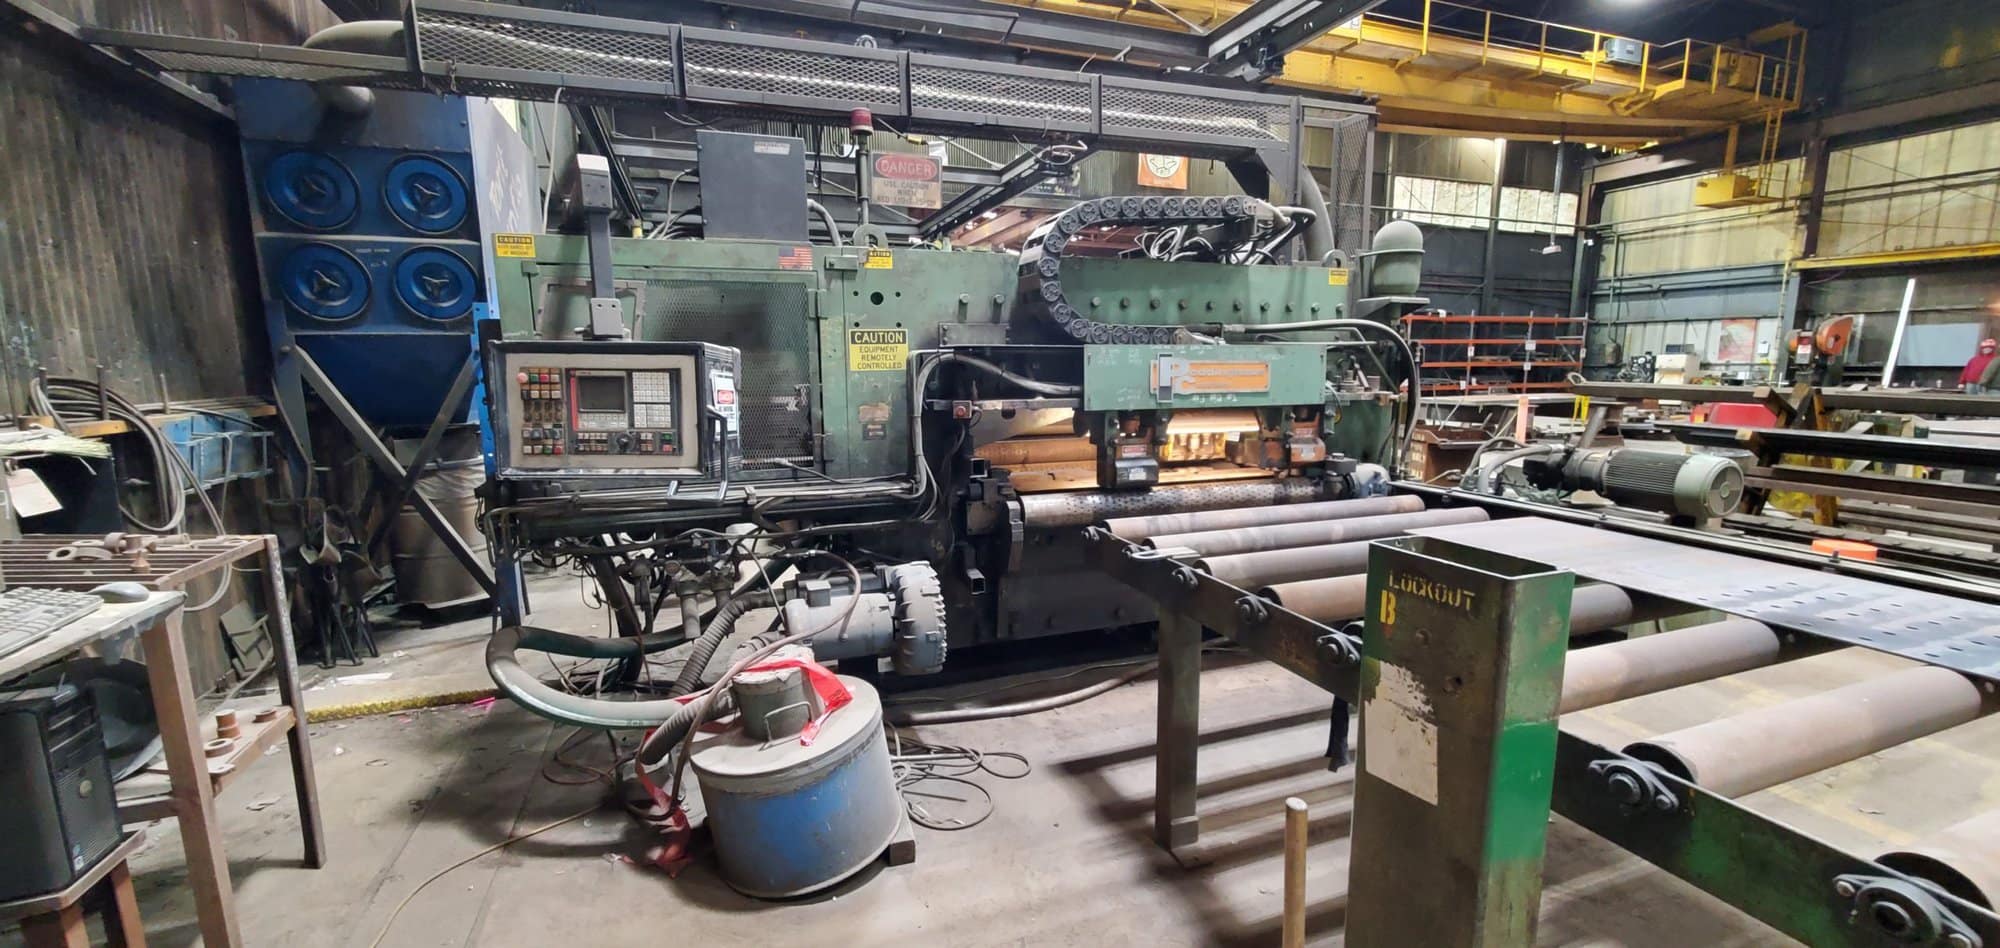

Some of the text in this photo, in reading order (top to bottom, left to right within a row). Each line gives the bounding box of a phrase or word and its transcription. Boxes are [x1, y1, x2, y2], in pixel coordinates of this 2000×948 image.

[880, 160, 933, 177] DANGER
[499, 236, 531, 244] CAUTION
[855, 332, 903, 343] CAUTION
[859, 345, 898, 353] EQUIPMENT
[1389, 570, 1475, 612] LOCKOUT
[1380, 590, 1396, 625] B
